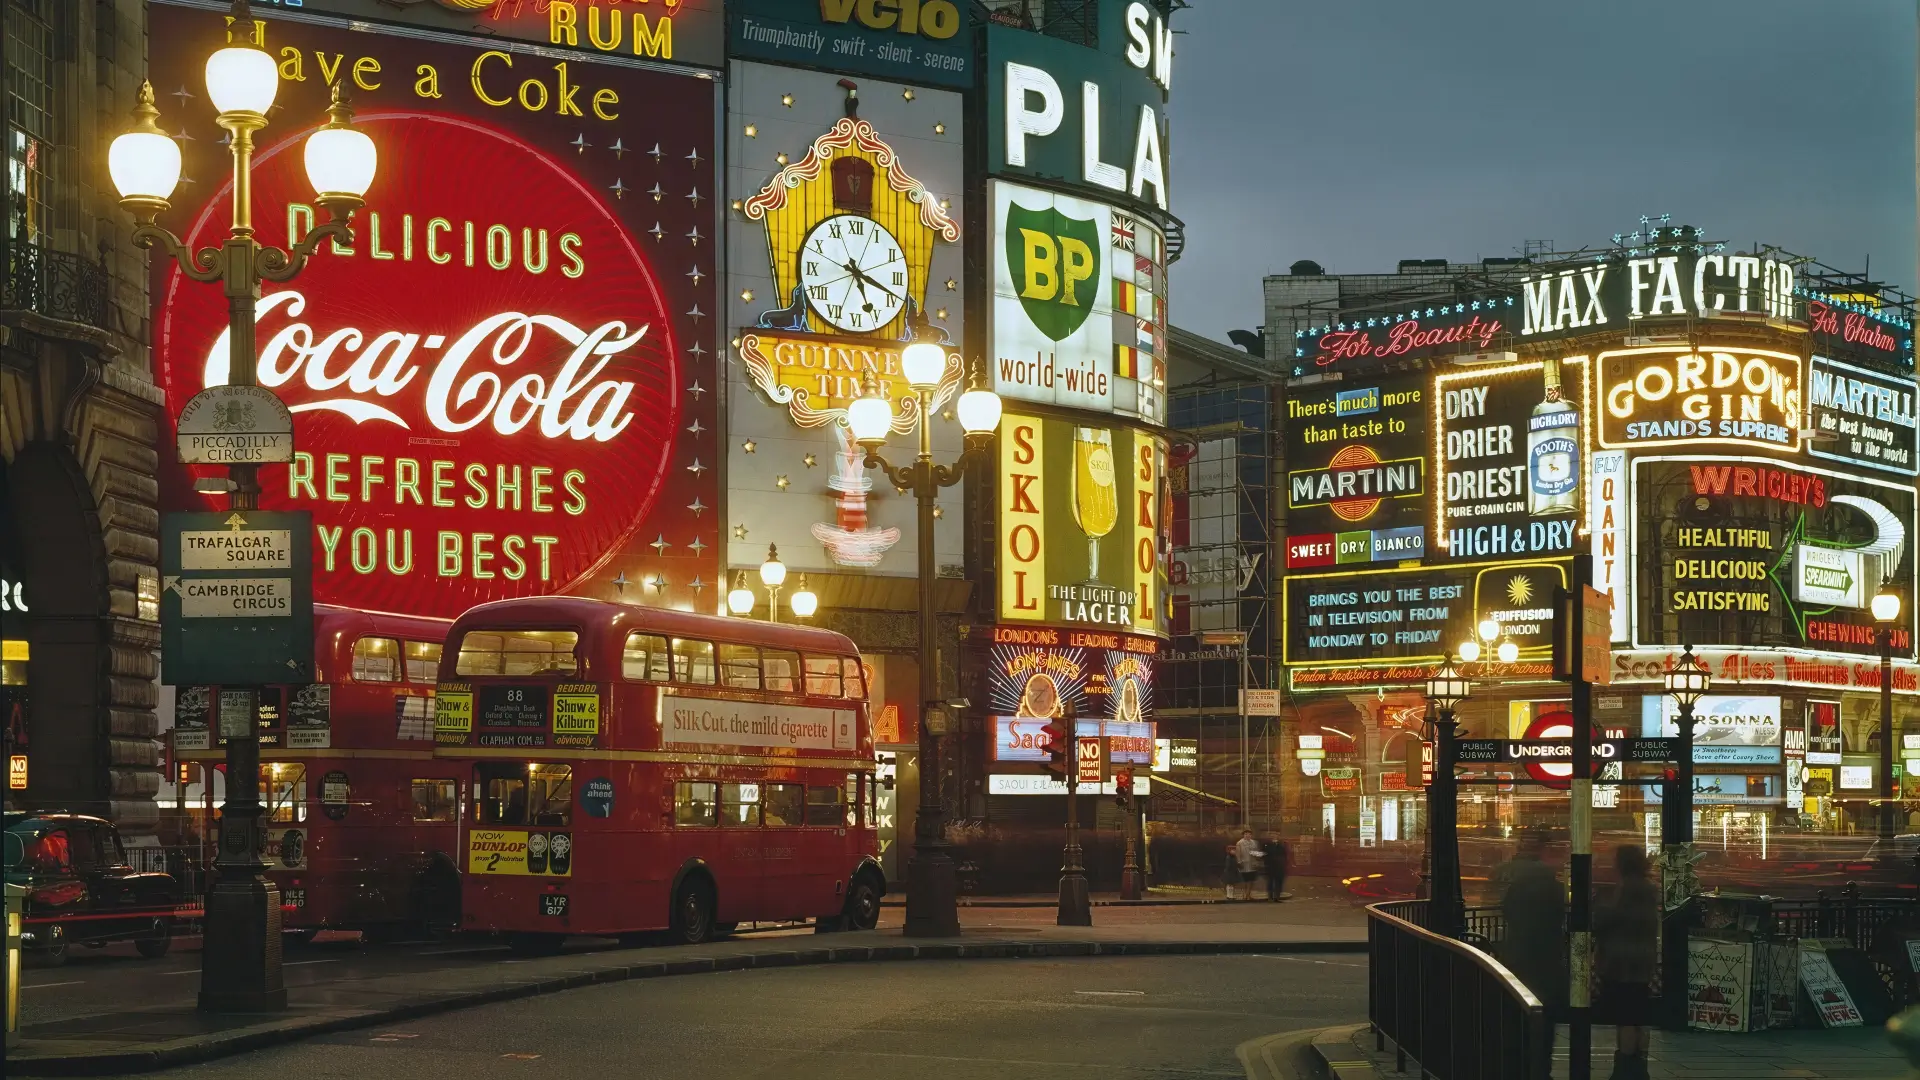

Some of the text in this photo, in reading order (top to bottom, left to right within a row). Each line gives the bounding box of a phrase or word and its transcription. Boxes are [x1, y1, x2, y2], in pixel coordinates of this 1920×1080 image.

[550, 1, 672, 59] RUM
[742, 20, 964, 72] Triumphantly swift silent serene
[414, 63, 442, 99] a
[471, 50, 620, 121] Coke
[828, 224, 842, 239] XI
[848, 220, 864, 236] XII
[814, 240, 824, 254] X
[888, 248, 896, 262] II
[806, 262, 819, 276] IX
[1018, 228, 1094, 306] BP
[892, 272, 904, 286] III
[808, 285, 828, 300] VIII
[886, 293, 898, 308] IV
[1521, 255, 1795, 336] MAX FACTOR
[825, 304, 842, 320] VII
[849, 312, 862, 328] VI
[872, 308, 882, 323] V
[1316, 315, 1502, 366] For Beauty
[204, 290, 649, 442] Coca-Cola
[999, 351, 1107, 396] world-wide
[1607, 352, 1798, 429] GORDON'S
[1287, 390, 1421, 418] There's much more
[1445, 386, 1490, 420] DRY
[1682, 394, 1763, 421] GIN
[1812, 370, 1916, 429] MARTELL
[1304, 418, 1406, 444] than taste to
[1626, 420, 1789, 444] STANDS SUPREME
[192, 436, 280, 448] PICCADILLY
[1447, 424, 1514, 461] DRIER
[1535, 440, 1576, 457] BOOTH'S
[207, 448, 263, 461] CIRCUS
[1594, 455, 1622, 474] FLY
[289, 451, 586, 516] REFRESHES
[1292, 464, 1416, 502] MARTINI
[1447, 464, 1526, 502] DRIEST
[1690, 464, 1825, 508] WRIGLEY'S
[1447, 502, 1525, 518] PURE GRAIN GIN
[1010, 425, 1040, 612] SKOL
[188, 537, 272, 549] TRAFALGAR
[1374, 535, 1422, 552] BIANCO
[1449, 520, 1576, 557] HIGH & DRY
[1678, 528, 1772, 550] HEALTHFUL
[318, 524, 560, 582] YOU BEST
[1291, 542, 1332, 559] SWEET
[1340, 540, 1366, 554] DRY
[226, 550, 286, 562] SQUARE
[1675, 559, 1766, 580] DELICIOUS
[1805, 567, 1848, 588] SPEARMINT
[188, 584, 274, 597] CAMBRIDGE
[1050, 584, 1078, 601] THE
[1082, 585, 1116, 602] LIGHT
[1310, 584, 1464, 608] BRINGS YOU THE BEST
[233, 598, 286, 609] CIRCUS
[1674, 591, 1770, 612] SATISFYING
[1064, 602, 1131, 626] LAGER
[1310, 606, 1449, 628] IN TELEVISION FROM
[994, 628, 1119, 649] LONDON'S LEADING
[1310, 629, 1442, 648] MONDAY TO FRIDAY
[1808, 620, 1875, 645] CHEWING
[1006, 652, 1080, 681] LONGINES
[1718, 654, 1776, 680] Ales
[1092, 674, 1106, 682] FINE
[1294, 668, 1326, 682] London
[507, 690, 524, 702] 88
[556, 684, 597, 694] BEDFORD
[1084, 686, 1114, 694] WATCHES
[463, 702, 470, 712] &
[588, 704, 596, 713] &
[436, 712, 469, 728] Kilburn
[556, 714, 595, 729] Kilburn
[674, 708, 700, 732] Silk
[730, 714, 749, 734] the
[752, 716, 778, 736] mild
[780, 720, 828, 744] cigarette
[1669, 714, 1774, 726] PRSONNA
[480, 736, 514, 746] CLAPHAM
[1462, 742, 1494, 750] PUBLIC
[1634, 742, 1668, 750] PUBLIC
[1784, 730, 1804, 750] AVIA
[1080, 742, 1100, 758] NO
[1459, 751, 1497, 760] SUBWAY
[1509, 743, 1616, 758] UNDERGRND
[1632, 750, 1672, 758] SUBWAY
[12, 759, 26, 772] NO
[1080, 760, 1100, 768] RIGHT
[1172, 758, 1196, 766] COMEDIES
[475, 832, 504, 840] NOW
[470, 842, 526, 852] DUNLOP
[486, 852, 500, 872] 2
[546, 896, 566, 906] LYR
[547, 906, 564, 916] 617
[1824, 1008, 1860, 1022] NEWS
